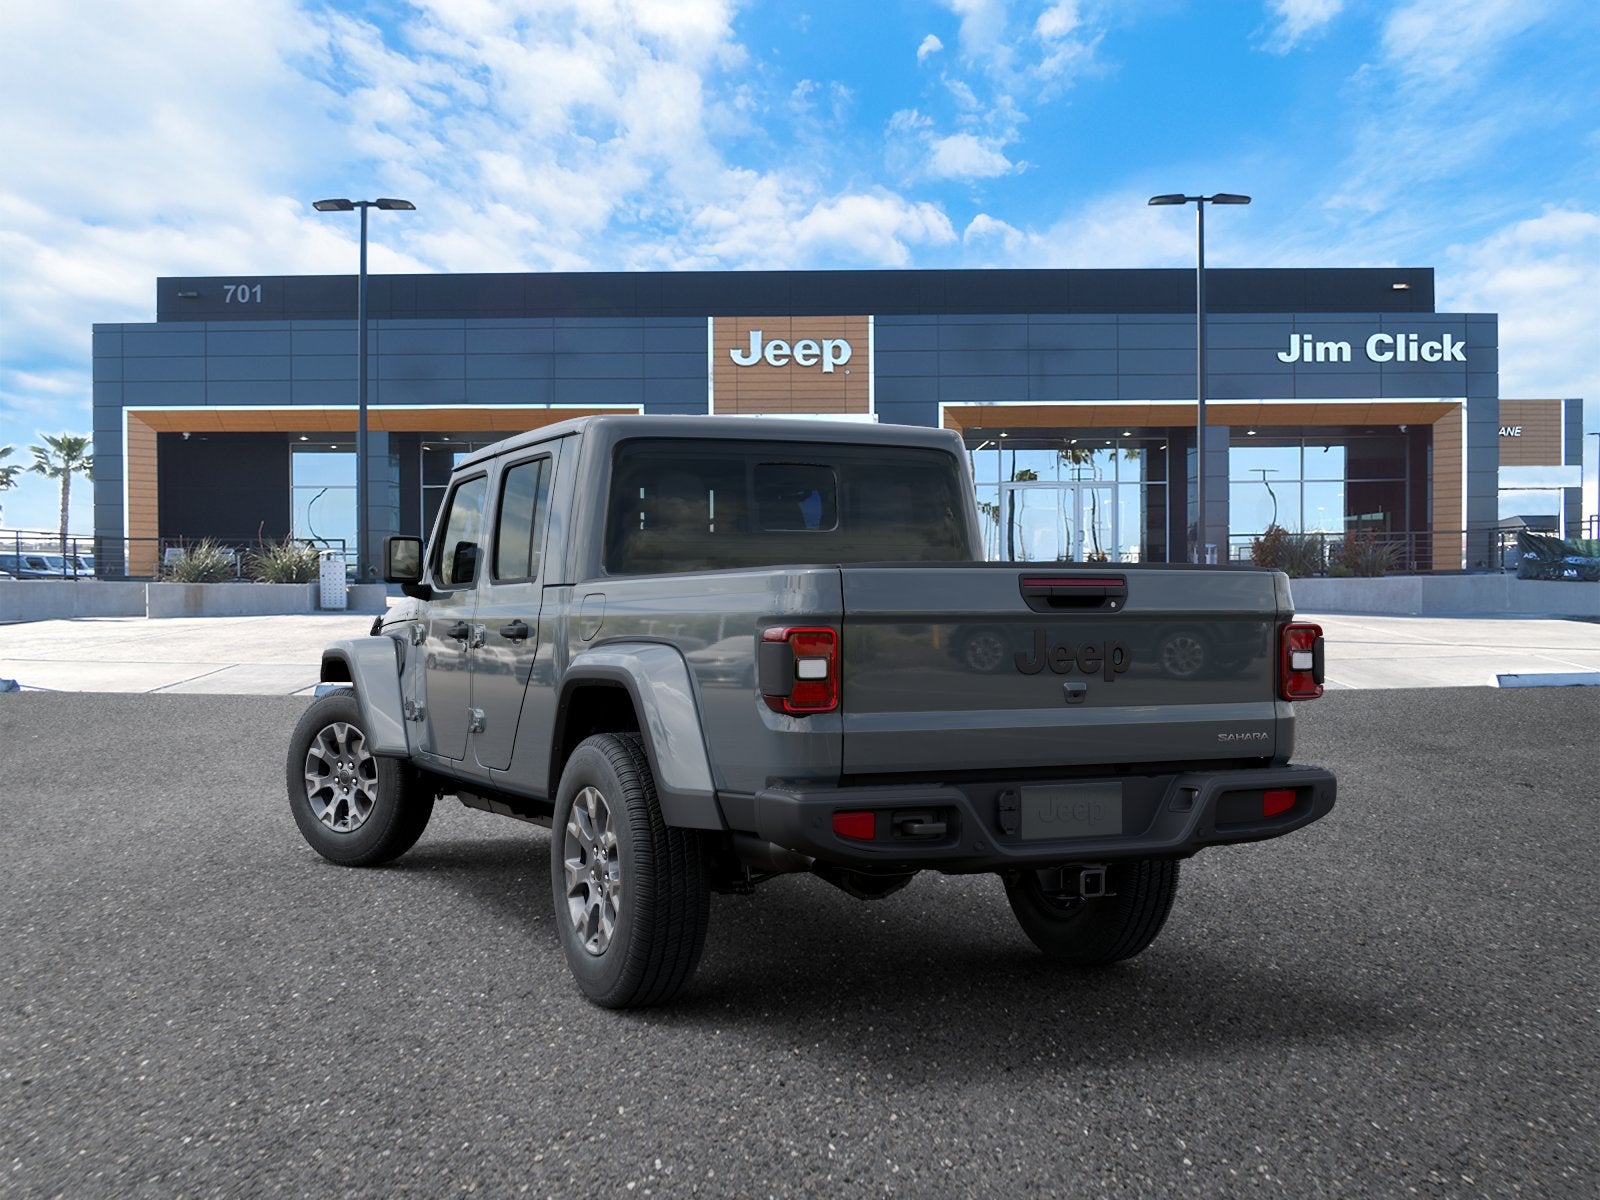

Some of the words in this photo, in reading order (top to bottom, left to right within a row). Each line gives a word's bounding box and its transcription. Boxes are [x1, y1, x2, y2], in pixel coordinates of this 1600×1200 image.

[223, 284, 262, 304] 701
[729, 330, 852, 374] Jeep
[1277, 333, 1352, 363] Jim
[1366, 333, 1467, 363] Click
[1014, 628, 1131, 682] Jeep
[1217, 732, 1270, 742] SAHARA
[1038, 792, 1105, 826] Jeep
